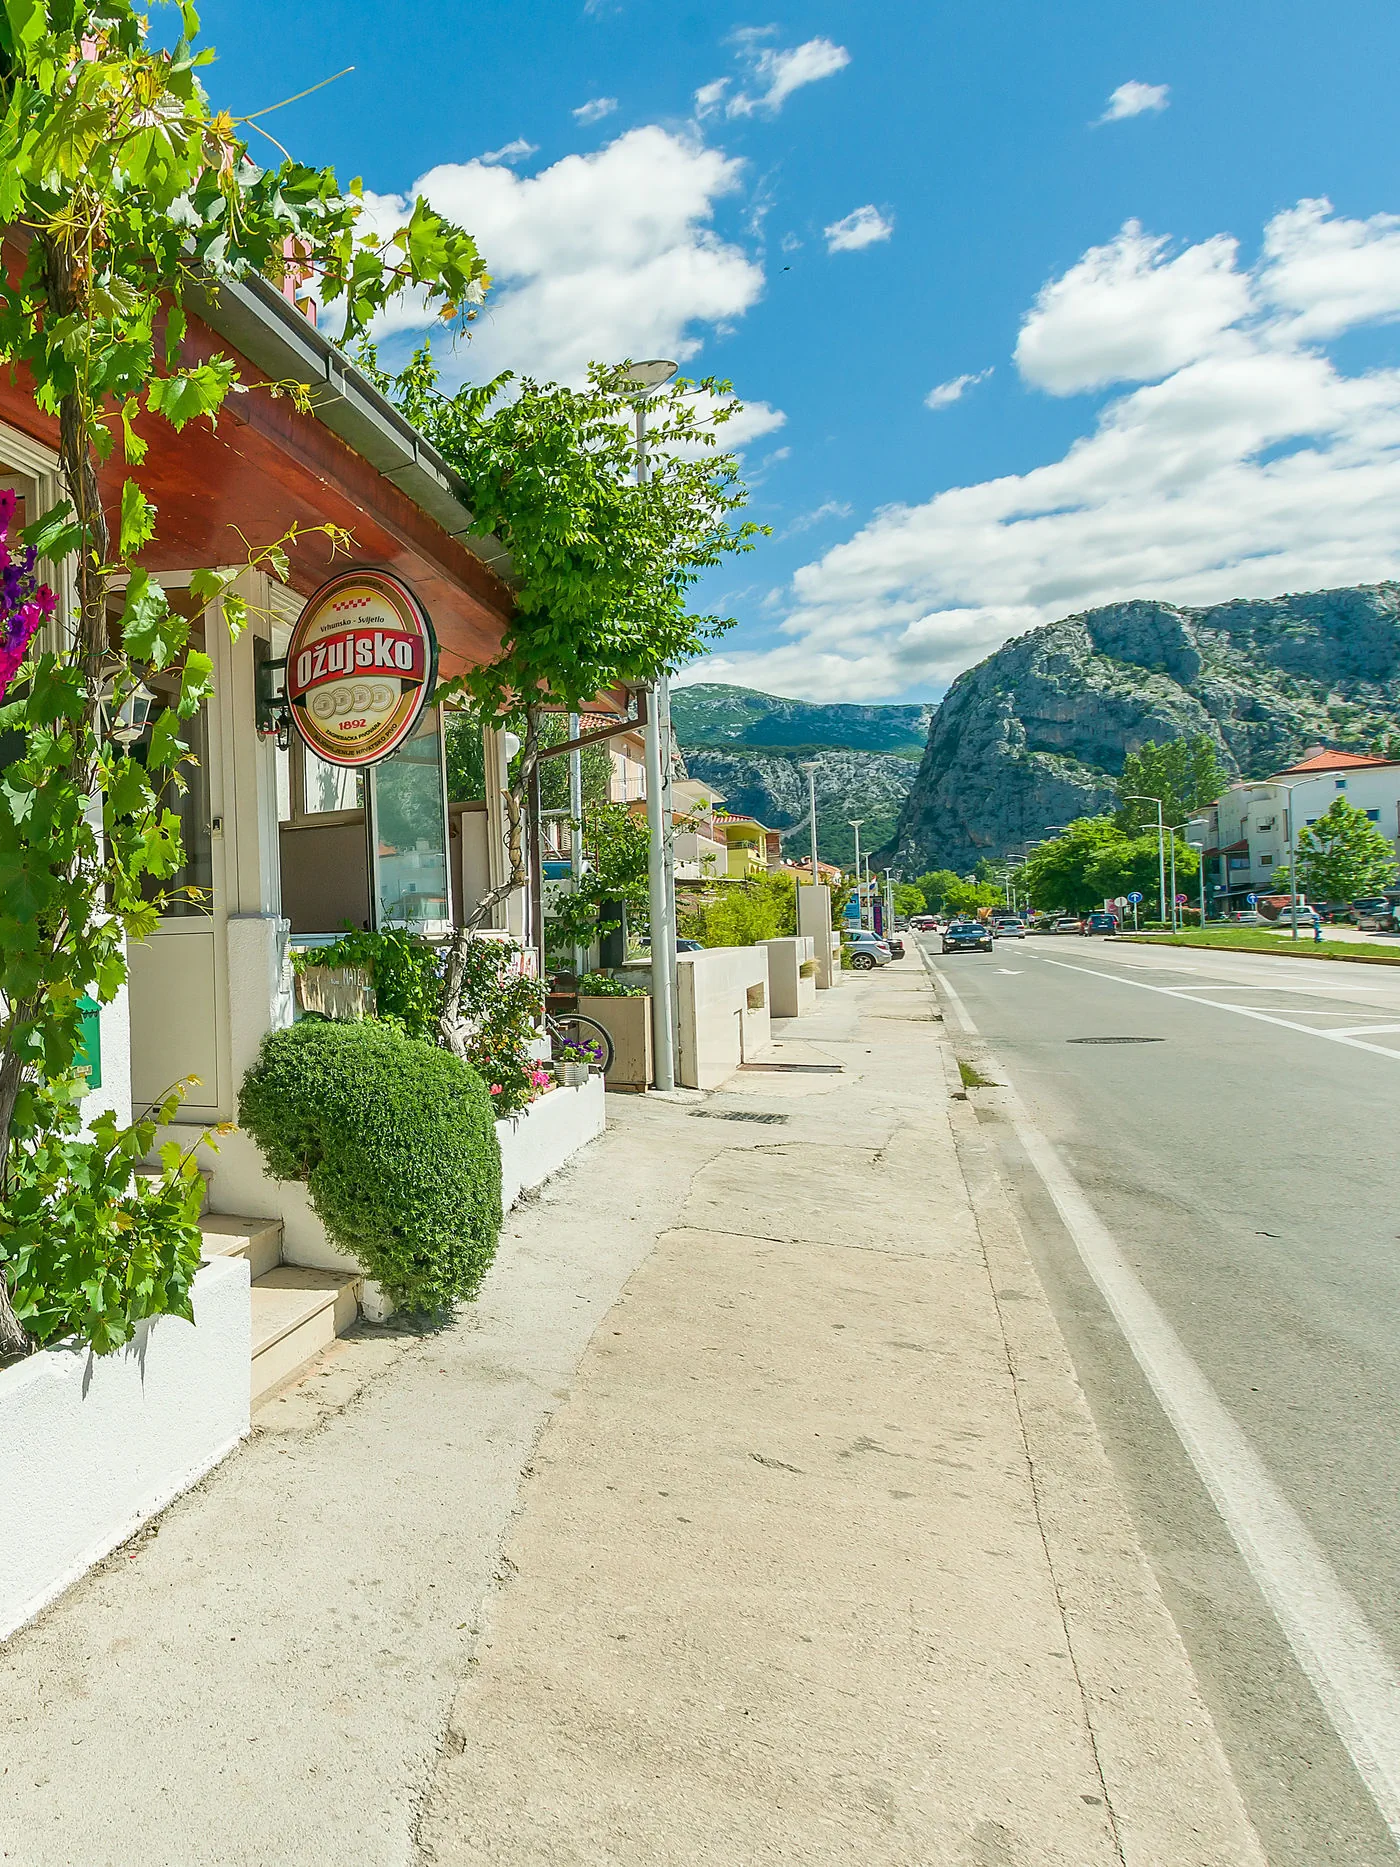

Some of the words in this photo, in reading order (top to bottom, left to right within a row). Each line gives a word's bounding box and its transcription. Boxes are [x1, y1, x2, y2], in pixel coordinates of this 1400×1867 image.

[320, 619, 352, 633] Vrhunsko
[297, 632, 413, 689] Ožujsko
[338, 718, 367, 731] 1892
[385, 723, 398, 737] PIVO
